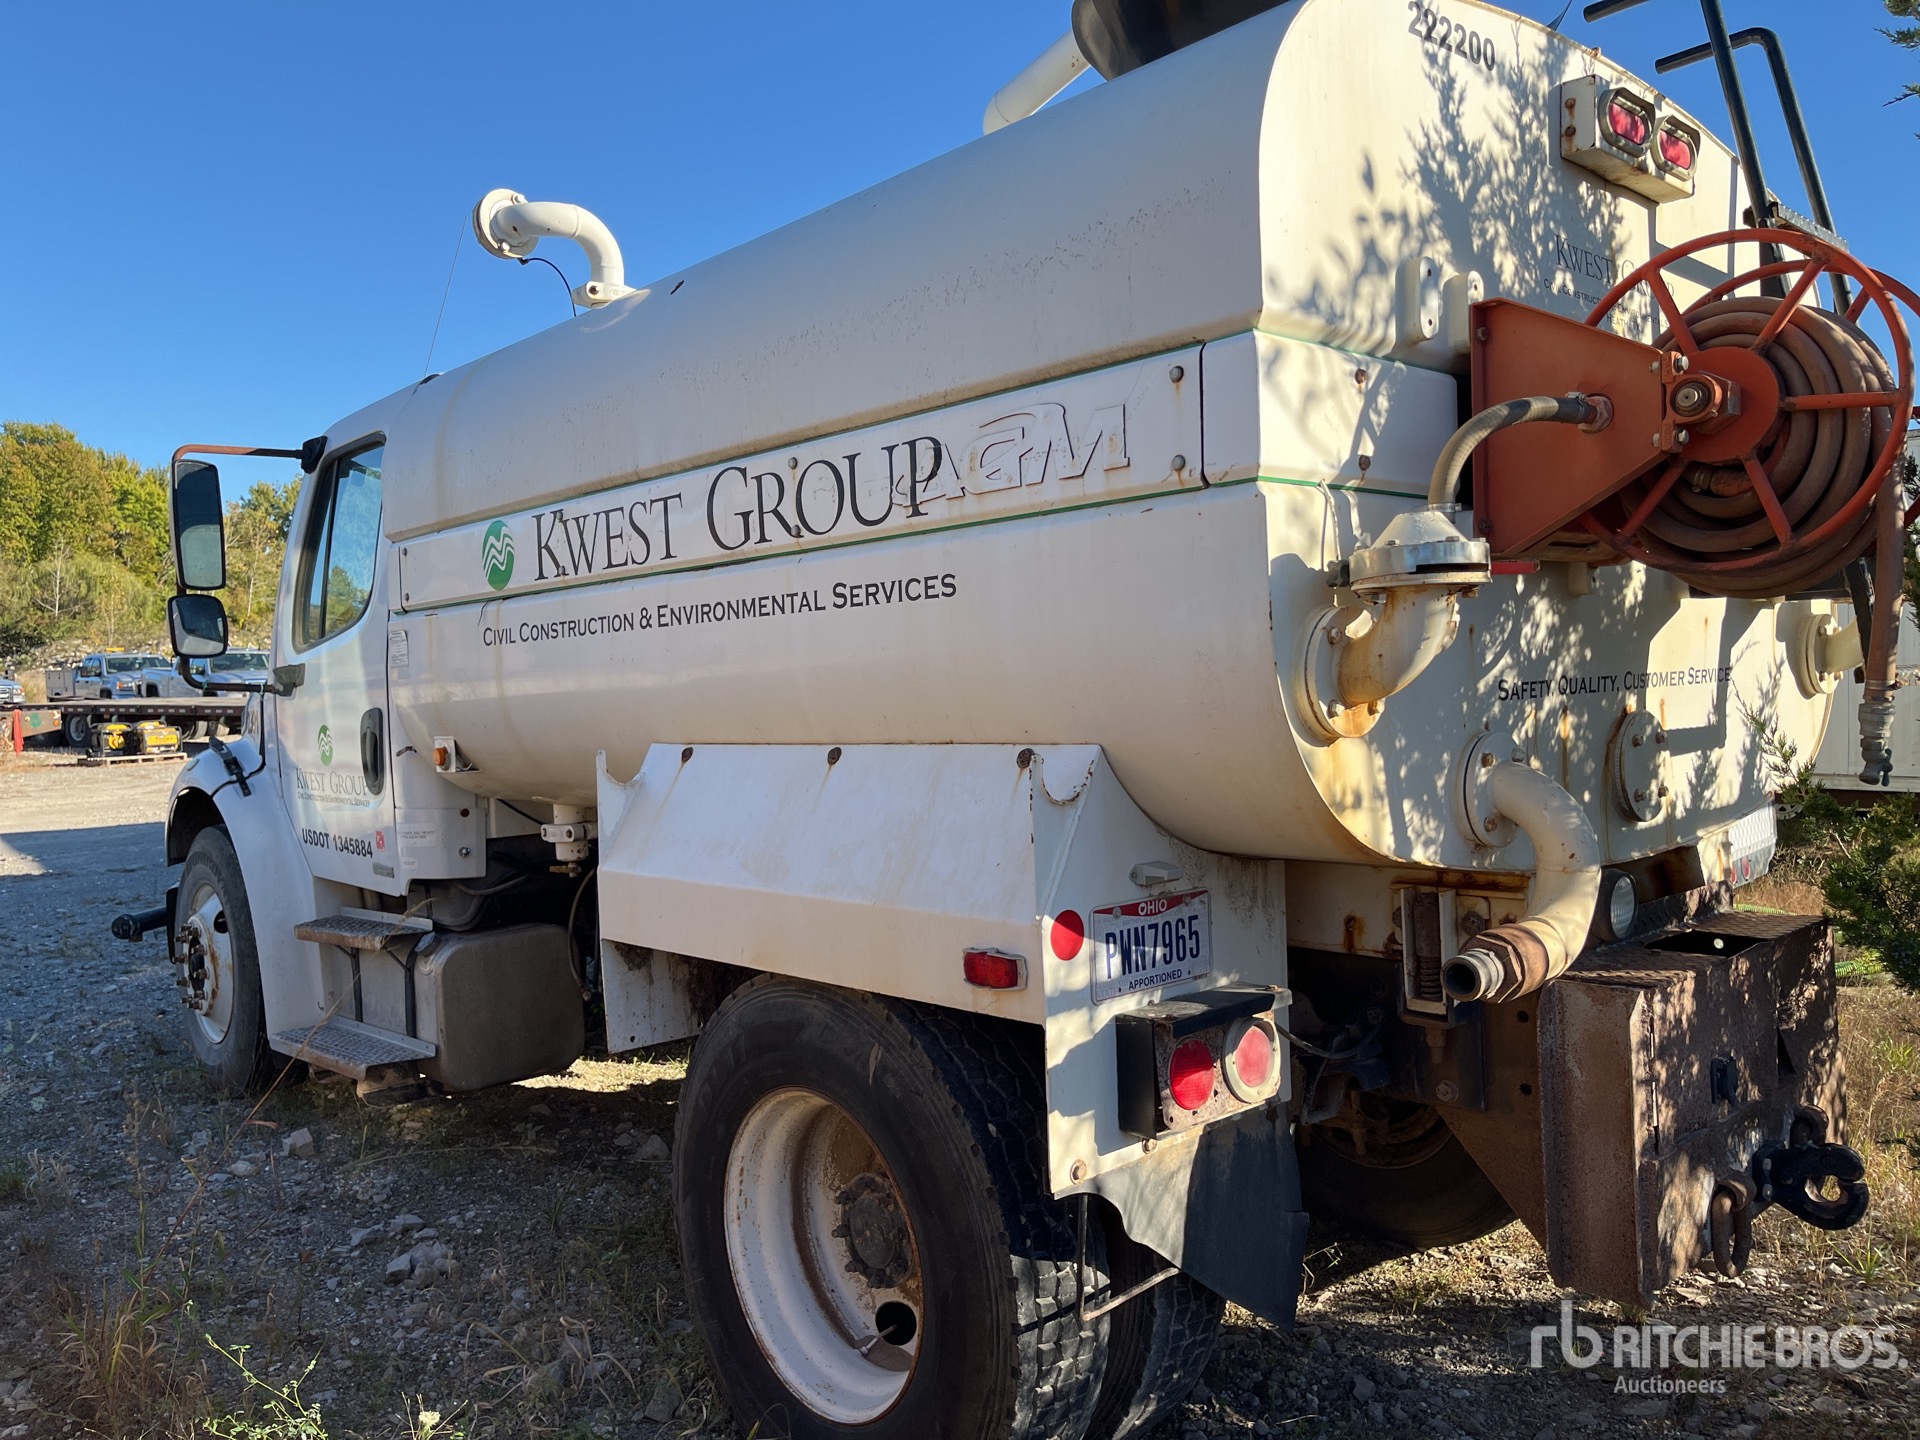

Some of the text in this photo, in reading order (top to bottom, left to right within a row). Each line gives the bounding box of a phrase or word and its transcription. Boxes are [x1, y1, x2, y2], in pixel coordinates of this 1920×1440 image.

[1408, 1, 1495, 71] 222200
[1554, 234, 1612, 285] KWEST
[532, 436, 943, 580] KWEST GROUP
[483, 573, 957, 646] CIVIL CONSTRUCTION & ENVIRONMENTAL SERVICES
[1624, 671, 1685, 691] CUSTOMER
[1688, 667, 1731, 685] SERVICE
[296, 768, 327, 792] KWEST
[302, 828, 330, 849] USDOT
[333, 834, 373, 858] 1345884
[1138, 899, 1167, 915] OHIO
[1105, 915, 1200, 979] PWN7965
[1129, 969, 1182, 990] APPORTIONED
